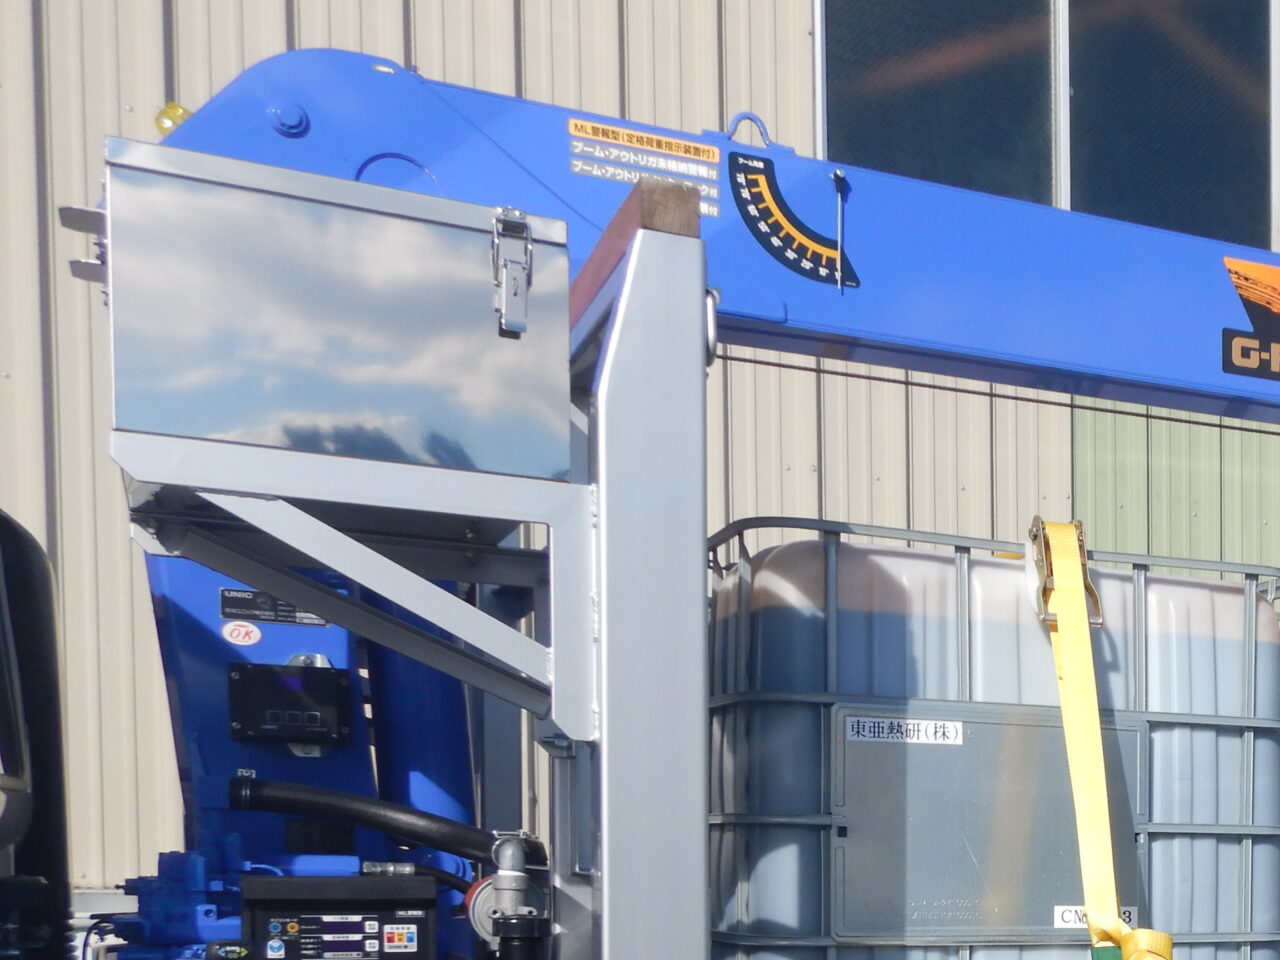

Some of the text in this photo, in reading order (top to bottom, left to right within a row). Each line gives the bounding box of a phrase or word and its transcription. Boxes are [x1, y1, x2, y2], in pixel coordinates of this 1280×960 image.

[224, 590, 254, 599] UNIC
[849, 719, 959, 742] 東亜熱研(株)
